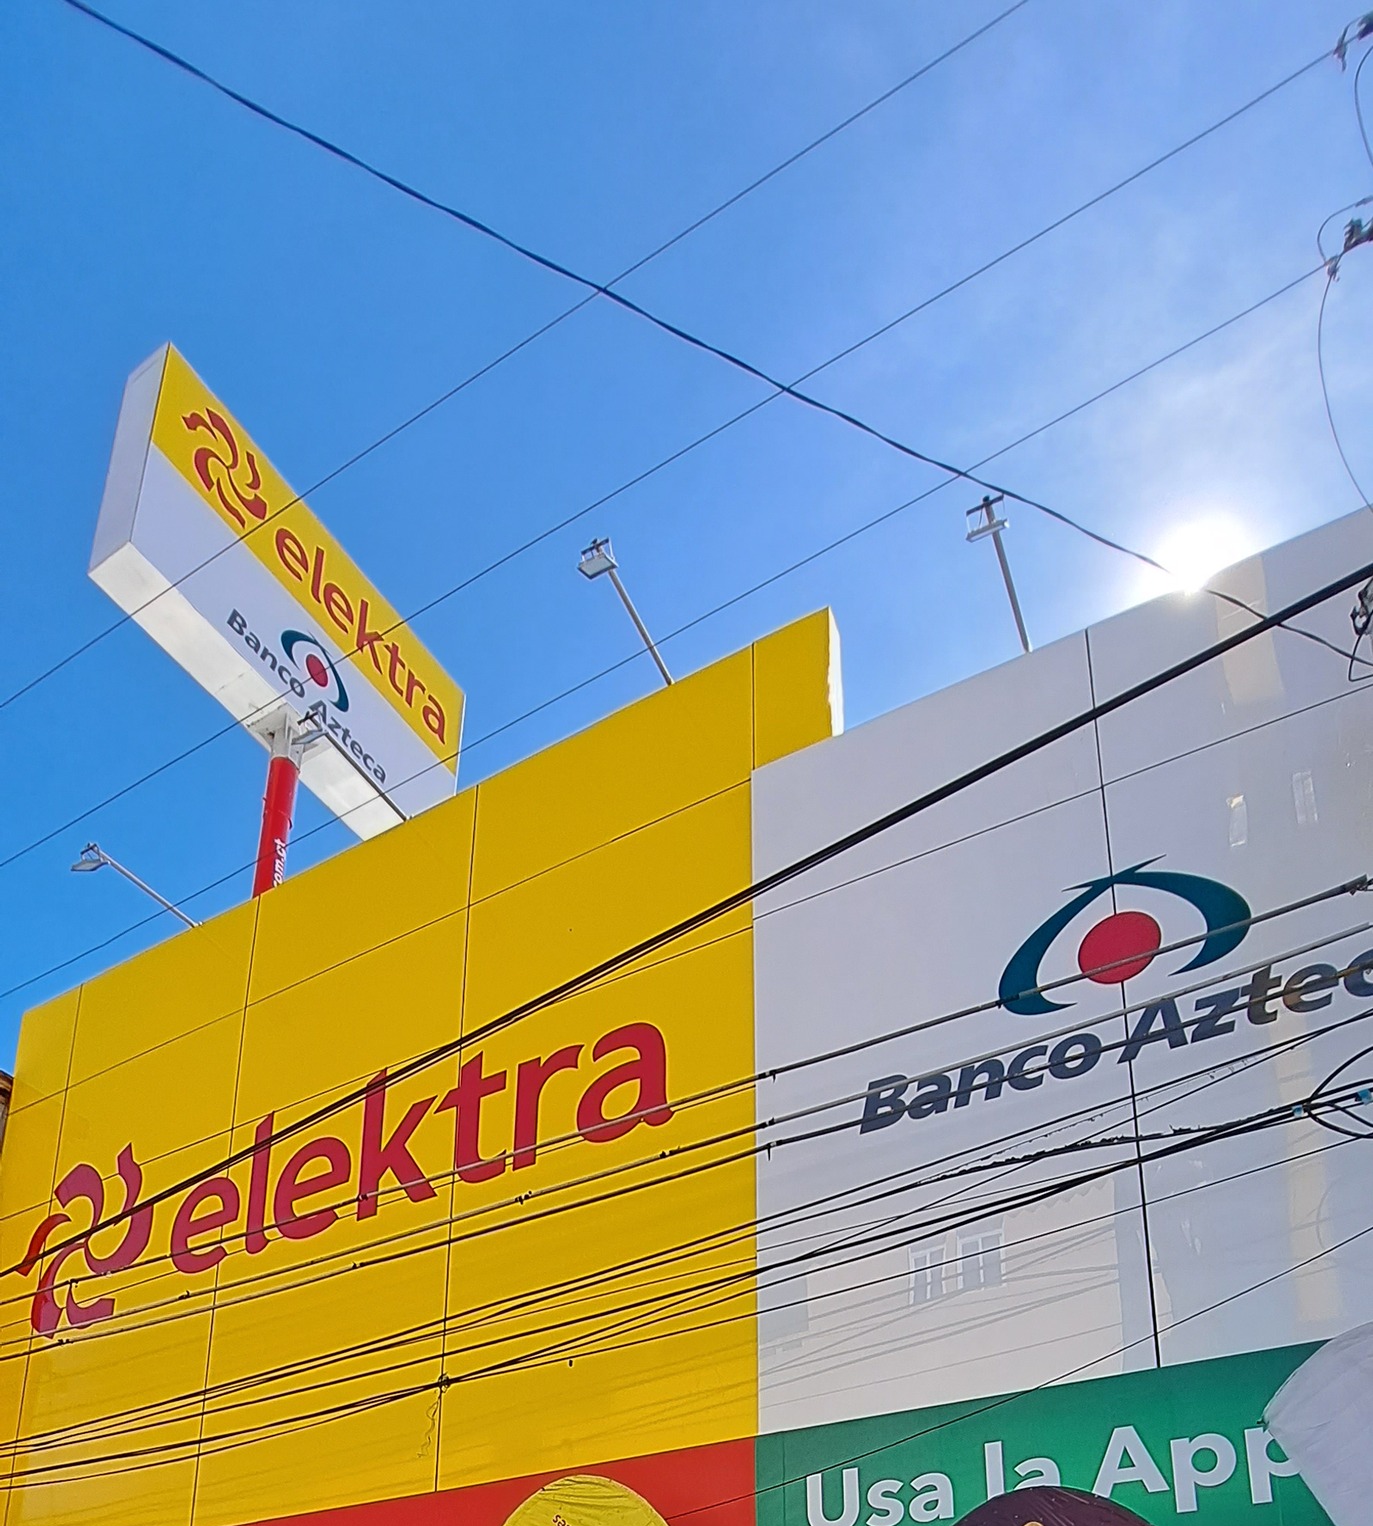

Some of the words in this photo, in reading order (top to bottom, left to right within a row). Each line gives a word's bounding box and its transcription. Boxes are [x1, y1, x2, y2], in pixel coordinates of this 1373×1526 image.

[226, 608, 306, 698] Banco
[305, 700, 387, 783] Azteca
[275, 527, 448, 745] elektra
[170, 1022, 674, 1274] elektra
[860, 1032, 1102, 1135] Banco
[983, 1440, 1061, 1501] la
[1091, 1425, 1301, 1514] App
